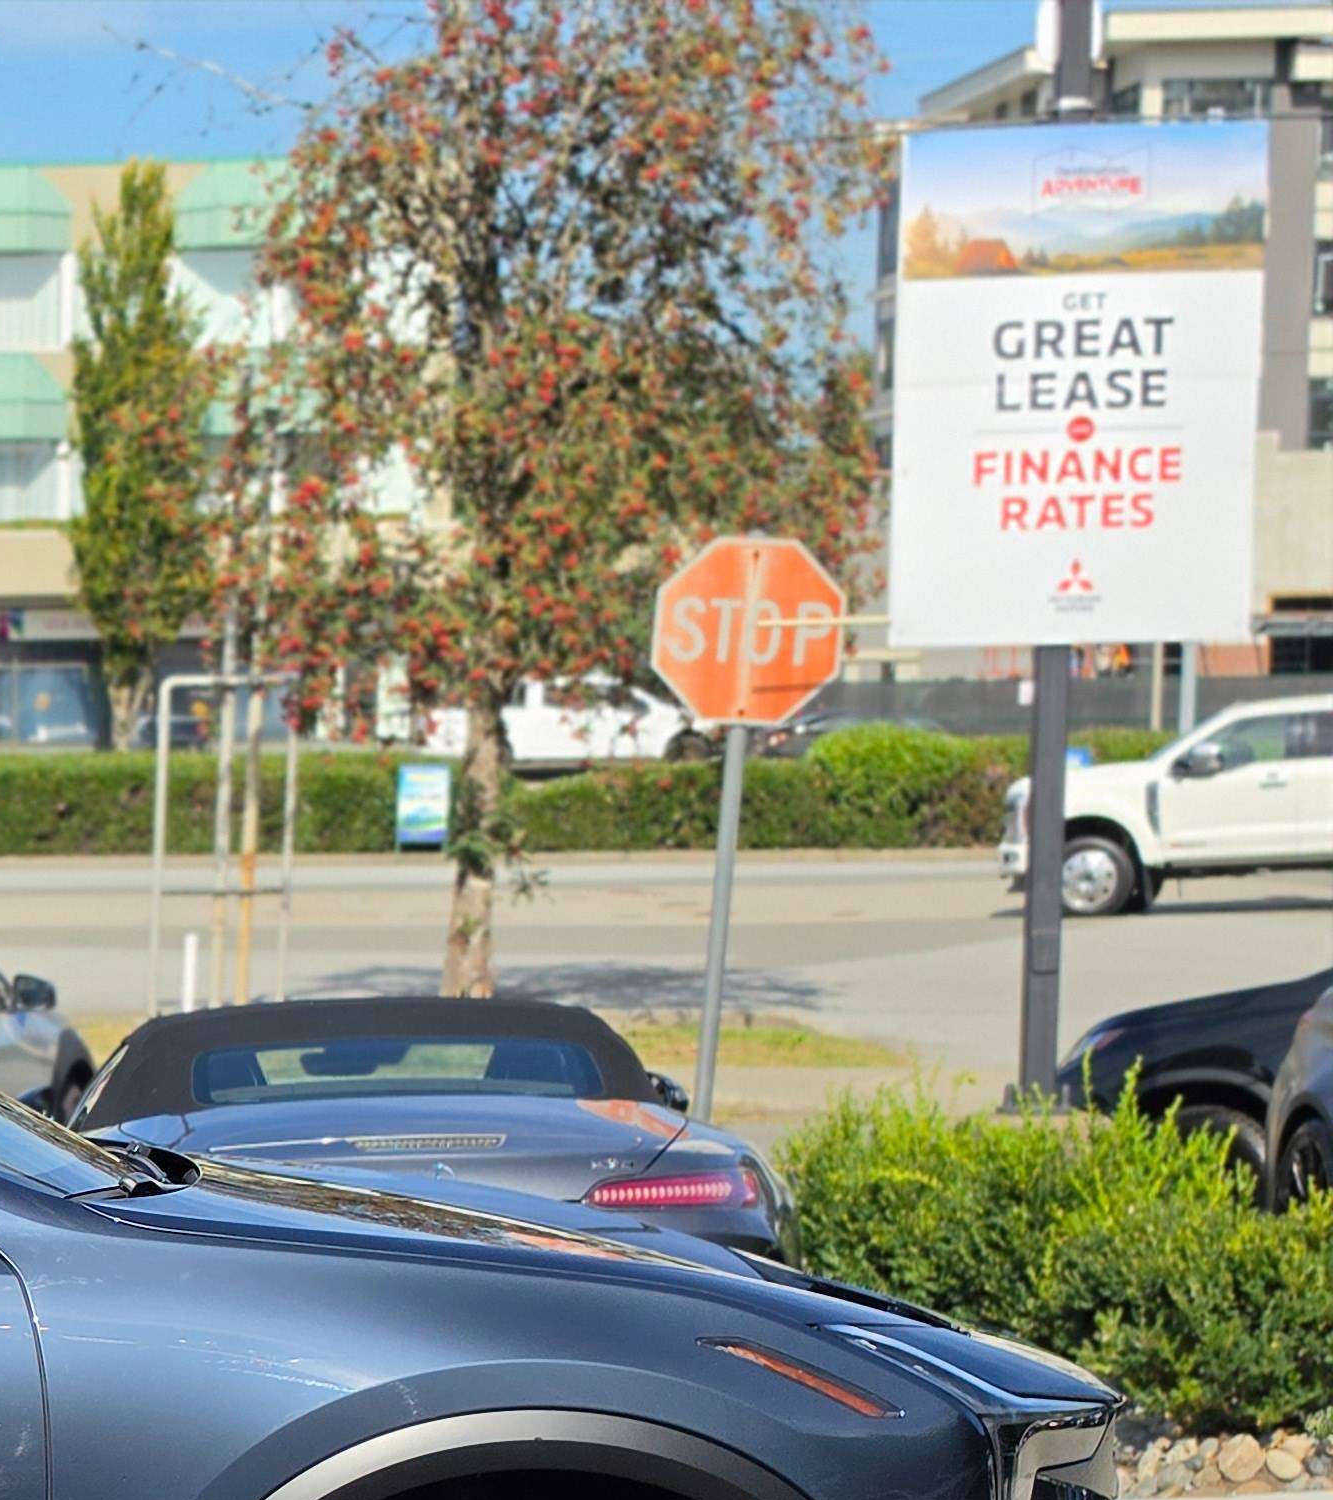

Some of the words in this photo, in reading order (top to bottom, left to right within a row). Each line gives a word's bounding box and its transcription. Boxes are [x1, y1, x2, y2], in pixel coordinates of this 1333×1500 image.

[1062, 292, 1107, 311] GET
[993, 317, 1175, 361] GREAT
[995, 369, 1169, 412] LEASE
[972, 447, 1183, 488] FINANCE
[999, 493, 1156, 532] RATES
[661, 596, 835, 667] STOP
